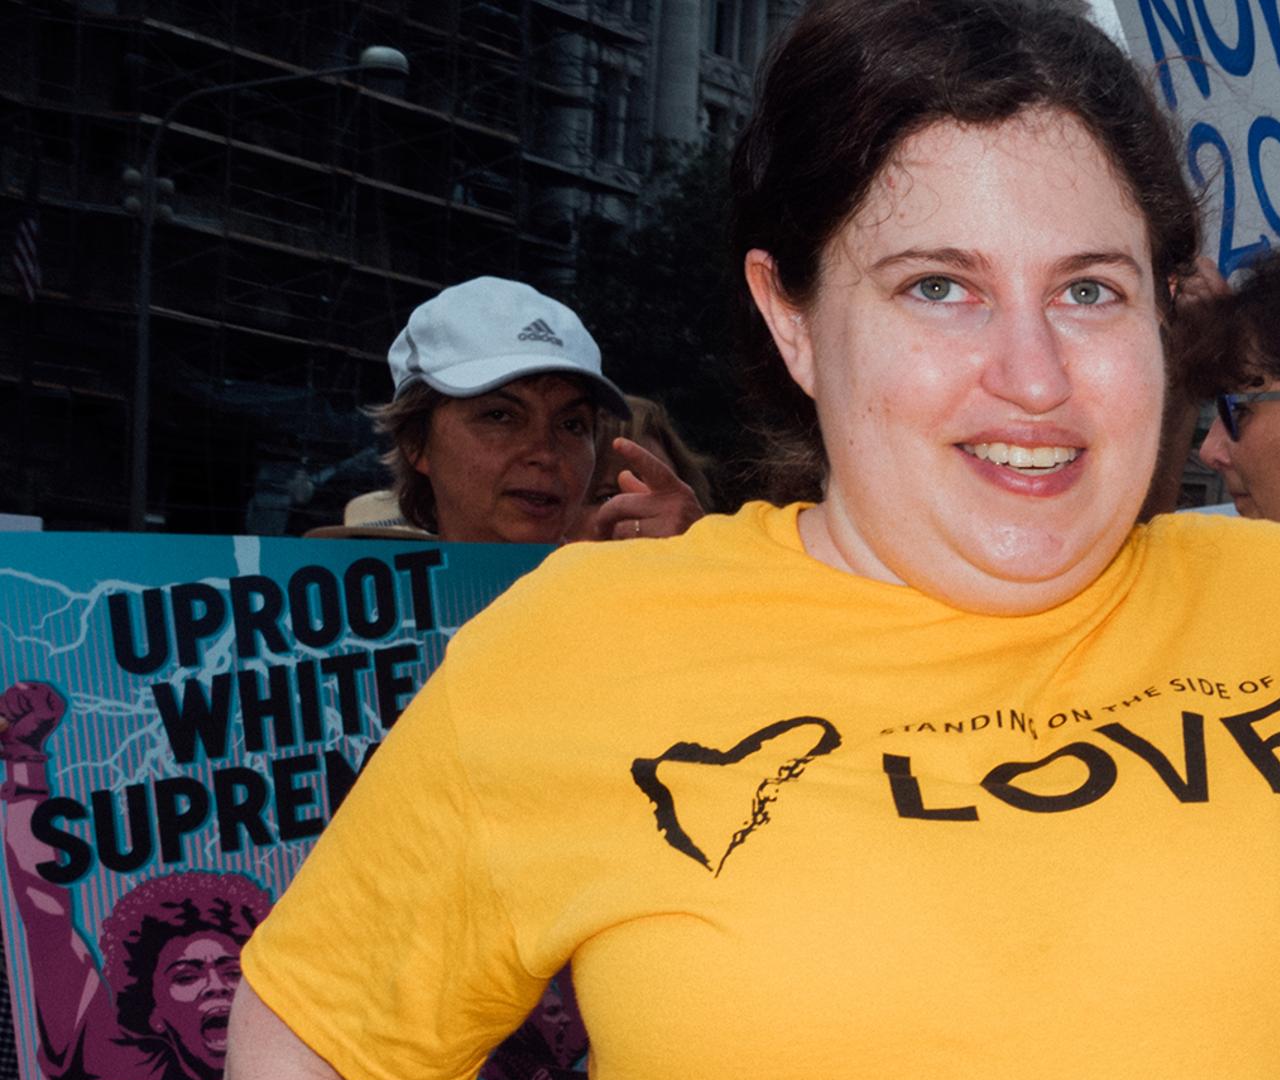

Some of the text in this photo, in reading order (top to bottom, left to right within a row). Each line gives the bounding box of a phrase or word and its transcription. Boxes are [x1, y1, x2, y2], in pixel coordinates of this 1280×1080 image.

[108, 549, 442, 675] UPROOT
[152, 644, 421, 764] WHITE
[1048, 708, 1093, 728] ON
[1102, 686, 1161, 712] THE
[1170, 677, 1231, 700] SIDE
[1239, 675, 1274, 695] OF
